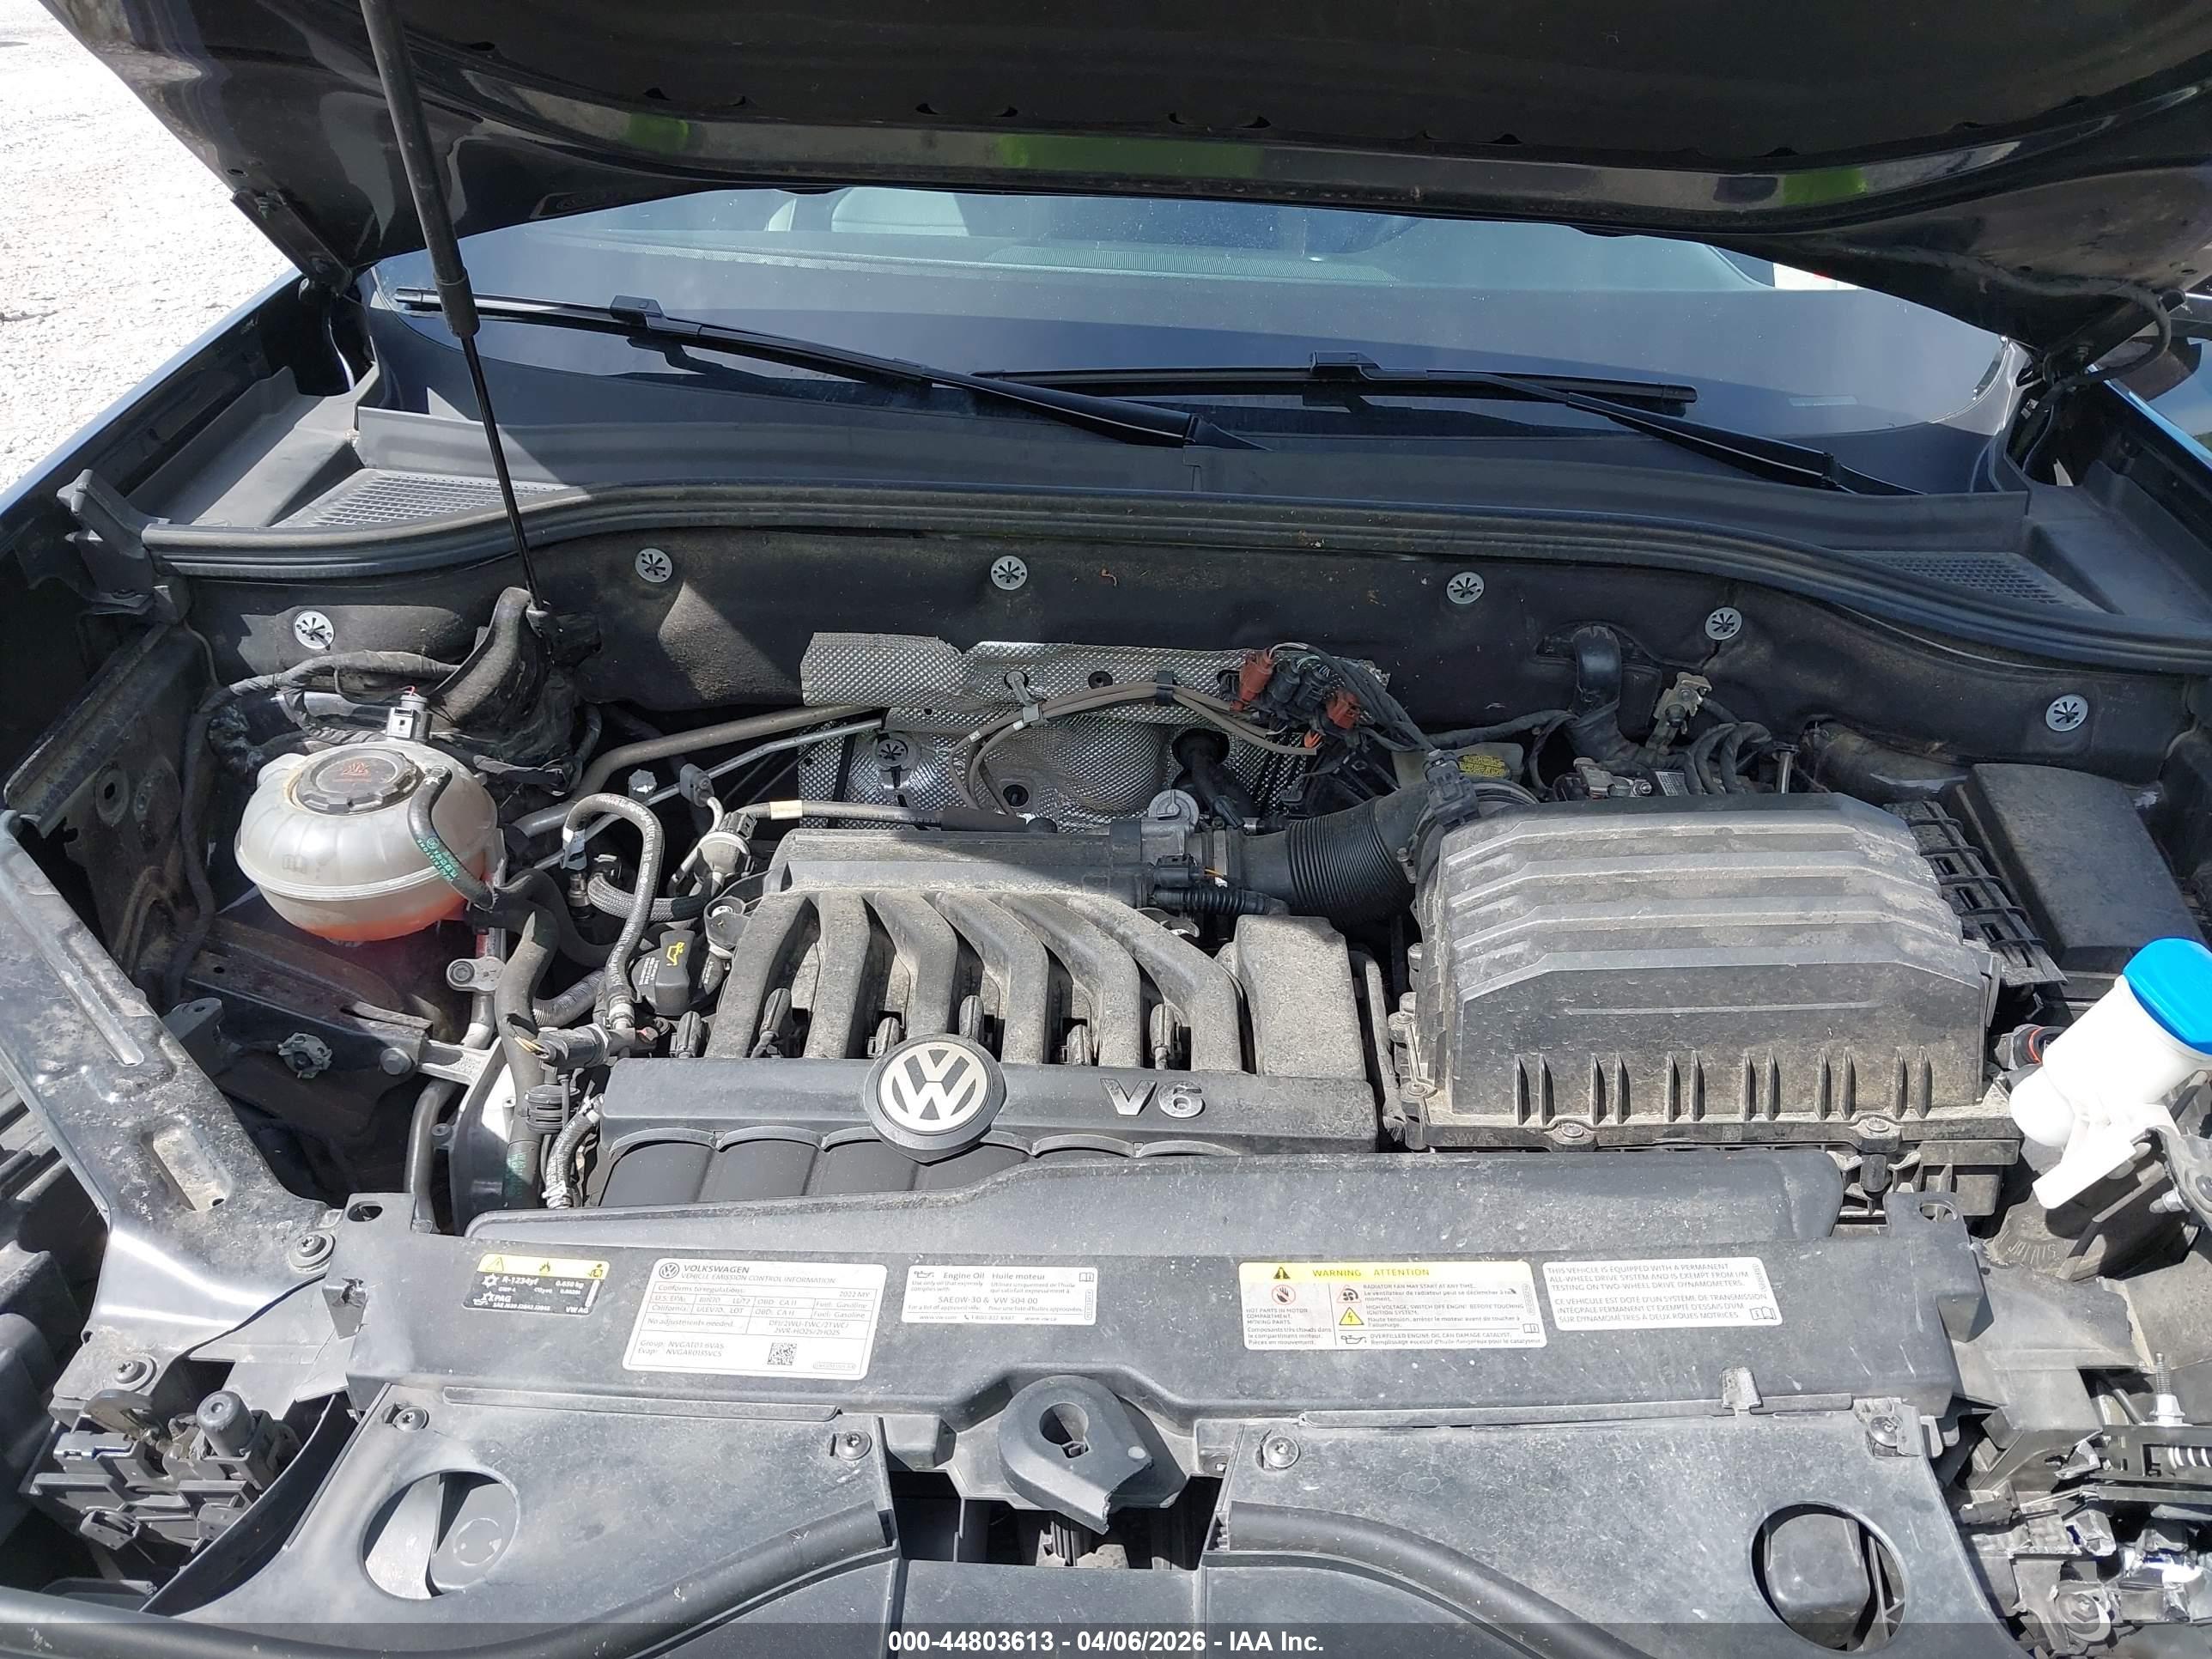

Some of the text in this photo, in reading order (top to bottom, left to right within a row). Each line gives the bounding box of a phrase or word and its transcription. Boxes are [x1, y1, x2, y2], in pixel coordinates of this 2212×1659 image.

[1100, 1079, 1205, 1119] V6
[1455, 1133, 1495, 1141] VW AG
[684, 1265, 750, 1273] VOLKSWAGEN
[1312, 1268, 1430, 1278] WARNING ATTENTION
[501, 1276, 539, 1286] R-1234yf
[659, 1318, 704, 1327] adjustments
